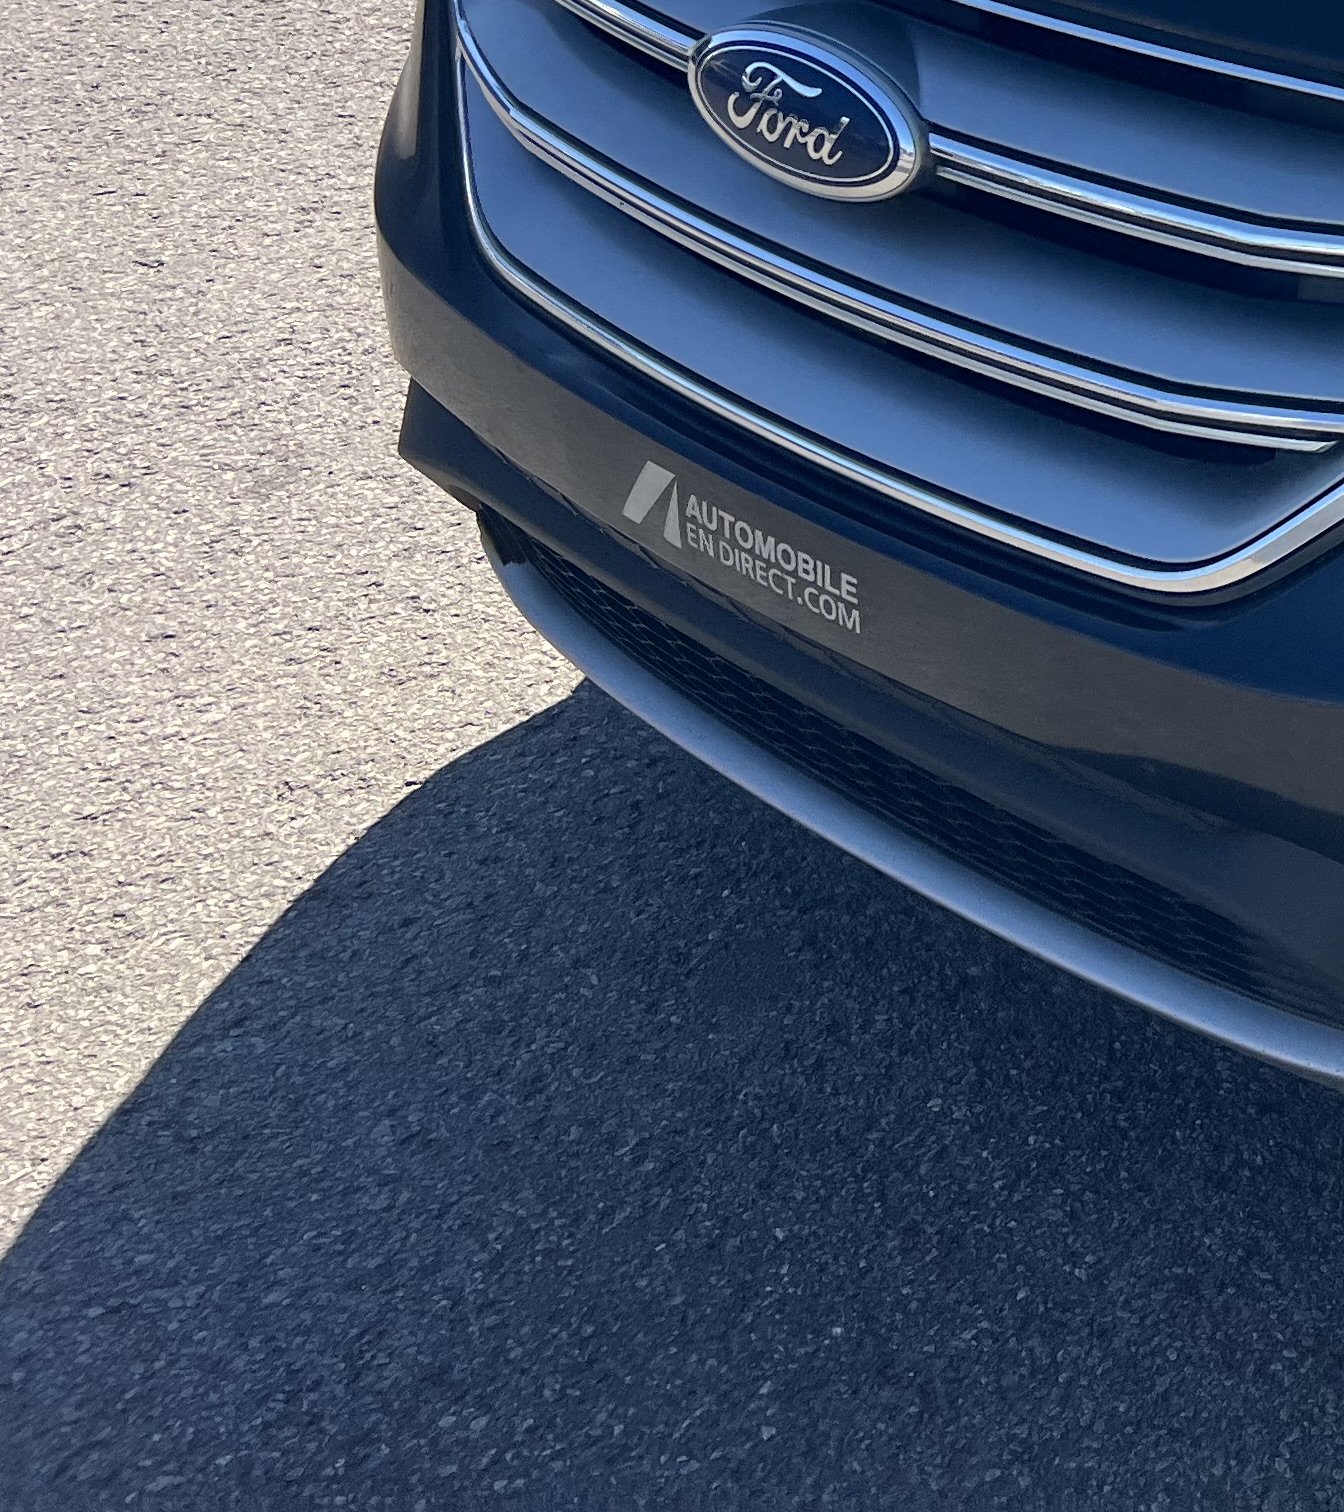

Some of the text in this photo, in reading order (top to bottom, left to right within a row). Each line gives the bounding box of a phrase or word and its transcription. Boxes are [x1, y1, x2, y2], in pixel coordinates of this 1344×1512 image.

[728, 60, 851, 166] Ford
[685, 493, 859, 605] AUTOMOBILE
[686, 521, 862, 634] EN DIRECT.COM
